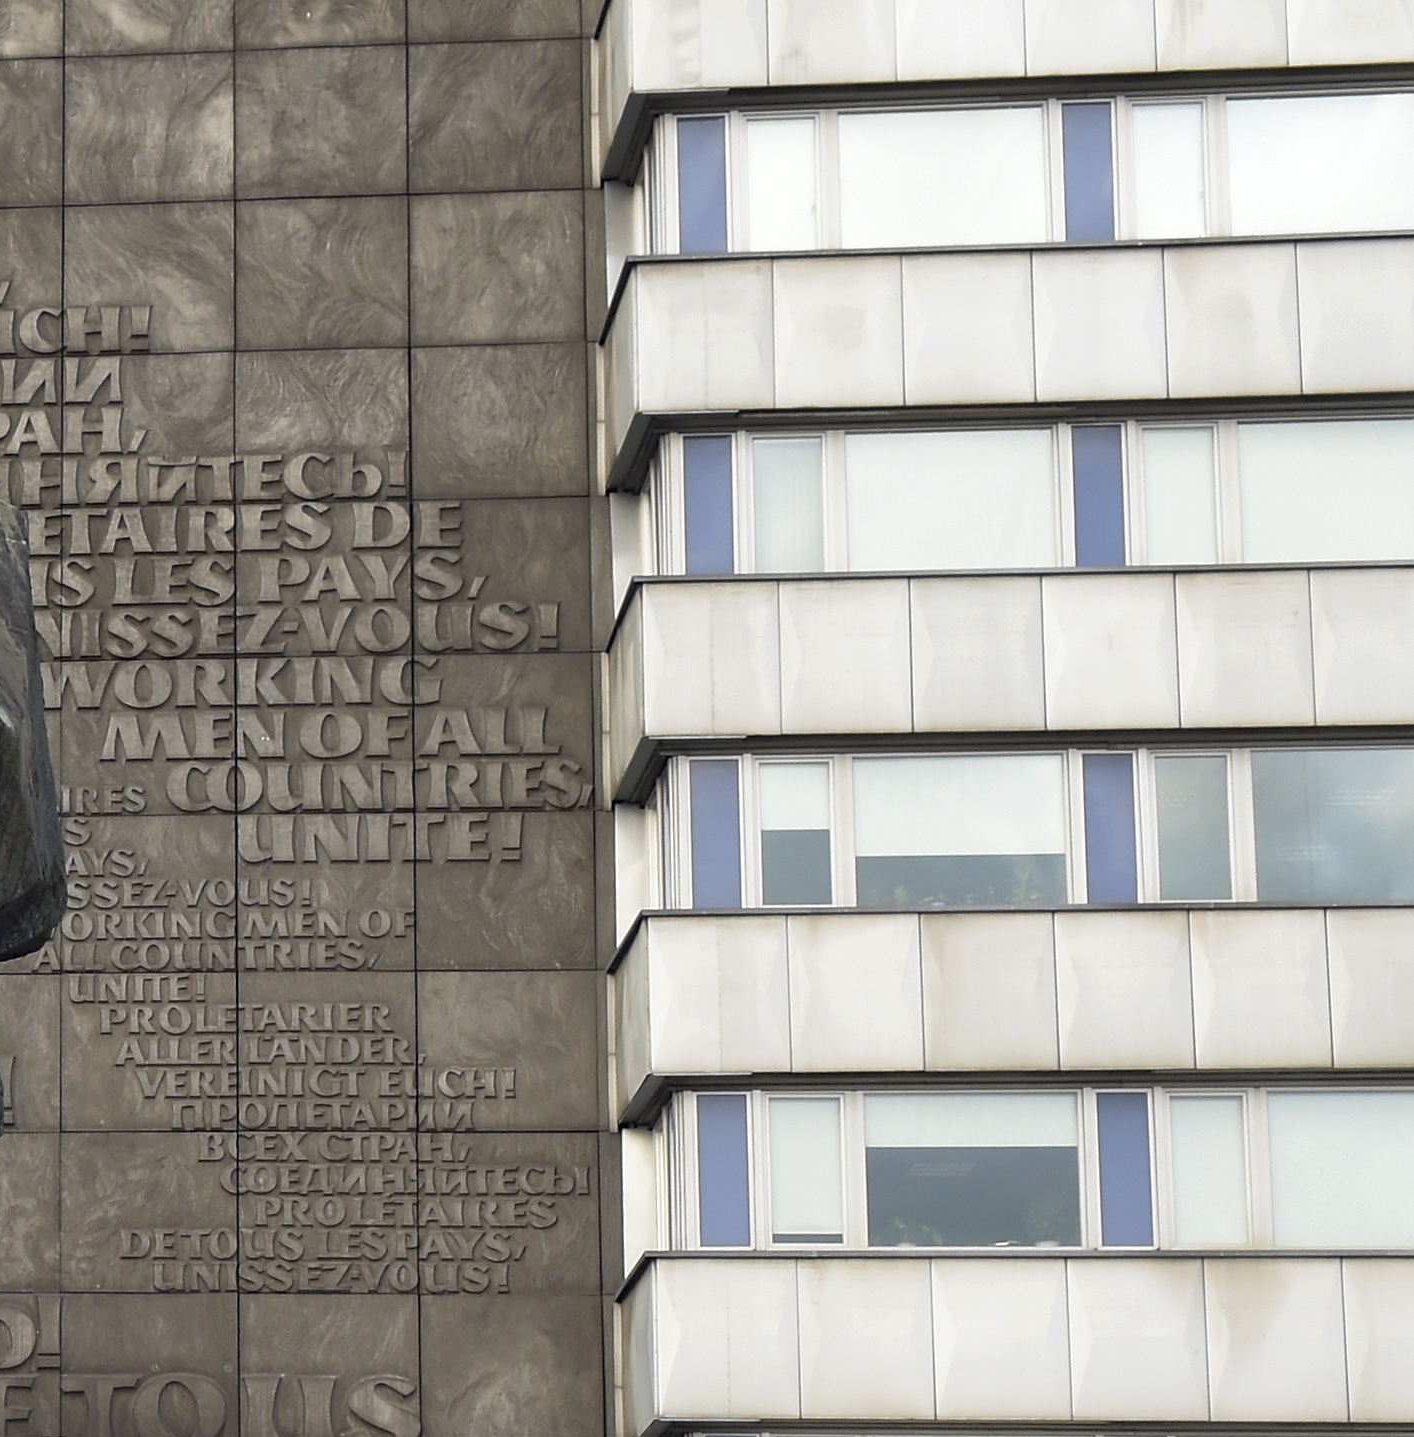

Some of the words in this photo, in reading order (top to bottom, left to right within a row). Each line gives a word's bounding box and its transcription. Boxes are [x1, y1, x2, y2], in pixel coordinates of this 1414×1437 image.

[349, 499, 465, 550] DE
[111, 554, 237, 606] LES
[99, 709, 287, 762] MEN
[298, 706, 412, 760] OF
[417, 705, 564, 758] ALL
[166, 758, 594, 813] COUNTRIES,
[237, 811, 525, 864] UNITE!
[242, 908, 349, 940] MEN
[357, 908, 417, 939] OF
[31, 942, 106, 973] ALL
[68, 973, 207, 1003] UNITE!
[99, 1002, 395, 1035] PROLETARIER
[113, 1035, 237, 1066] ALLER
[131, 1067, 367, 1099] VEREINIGT
[377, 1066, 518, 1100] EUCH!
[170, 1100, 477, 1132] ПРОЛЕТАРИИ
[197, 1131, 308, 1162] ВСЕХ
[316, 1131, 472, 1163] СТРАН,
[119, 1229, 177, 1260] DE
[180, 1228, 306, 1261] TOUS
[317, 1230, 393, 1261] LES
[396, 1229, 528, 1262] PAYS,
[152, 1260, 512, 1294] UNISSEZ-VOUS!
